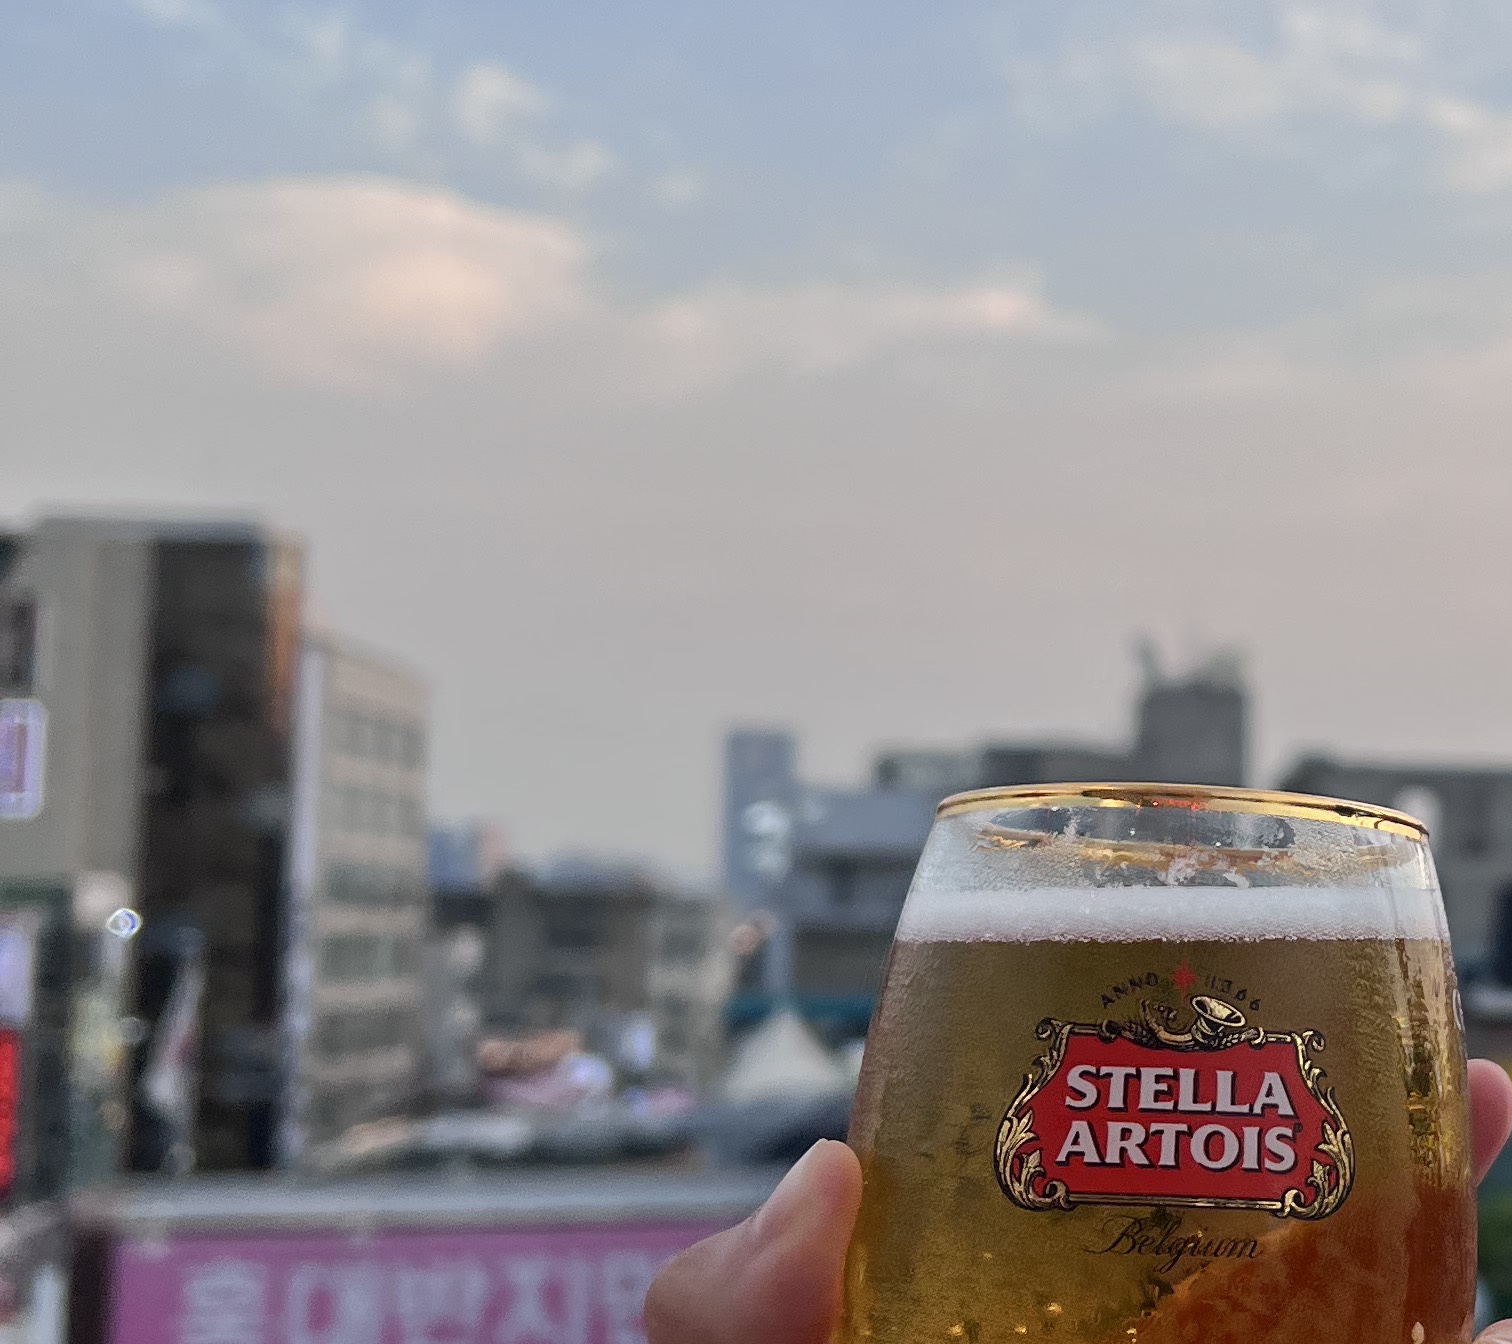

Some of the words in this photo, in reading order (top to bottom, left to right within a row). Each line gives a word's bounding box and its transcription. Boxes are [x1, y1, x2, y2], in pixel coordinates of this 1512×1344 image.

[1101, 972, 1159, 1009] ANNO
[1206, 975, 1261, 1011] 1366
[1064, 1064, 1295, 1117] STELLA
[1055, 1121, 1297, 1173] ARTOIS
[1082, 1214, 1264, 1274] Belgium
